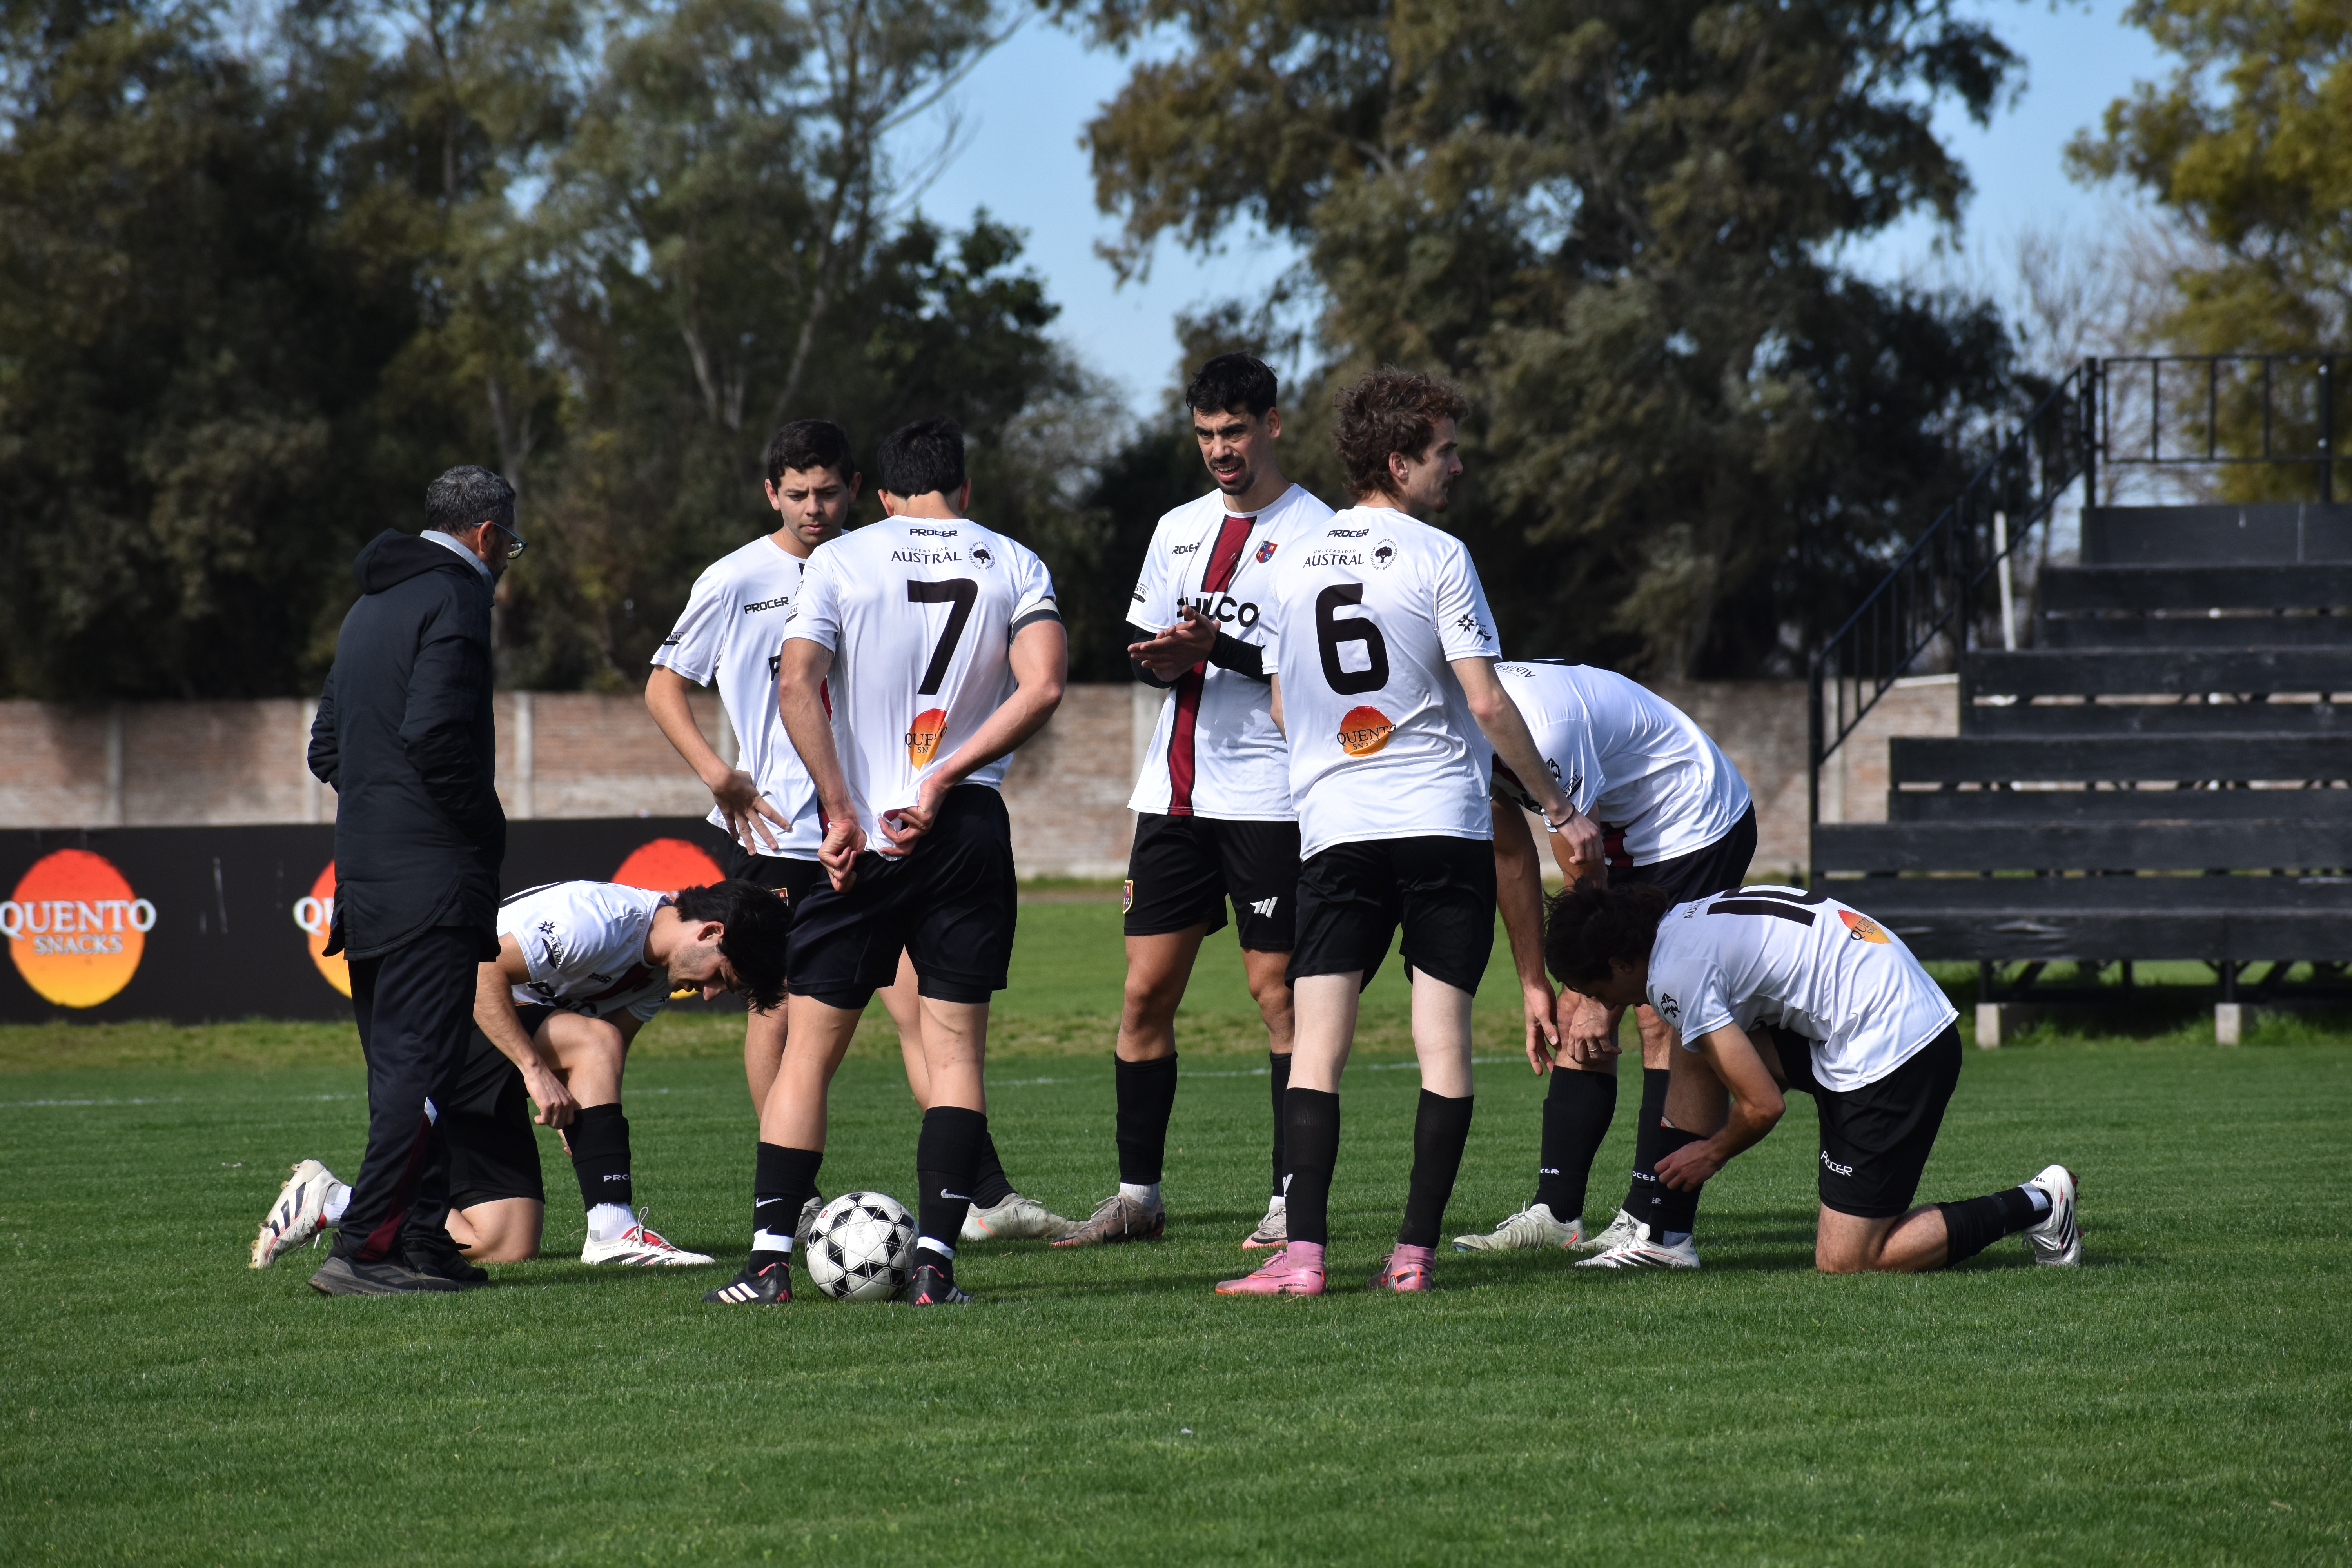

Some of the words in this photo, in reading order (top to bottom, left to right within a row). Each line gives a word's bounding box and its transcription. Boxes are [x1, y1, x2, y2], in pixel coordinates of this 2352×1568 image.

[910, 528, 958, 537] PROCER
[1327, 528, 1370, 537] PROCER
[891, 550, 962, 564] AUSTRAL
[1303, 553, 1365, 568] AUSTRAL
[744, 596, 790, 614] PROCER
[907, 577, 978, 695] 7
[1315, 583, 1389, 696] 6
[1336, 724, 1396, 746] QUENTO
[0, 898, 157, 940] QUENTO
[34, 934, 123, 955] SNACKS
[549, 936, 562, 968] AUSTRAL
